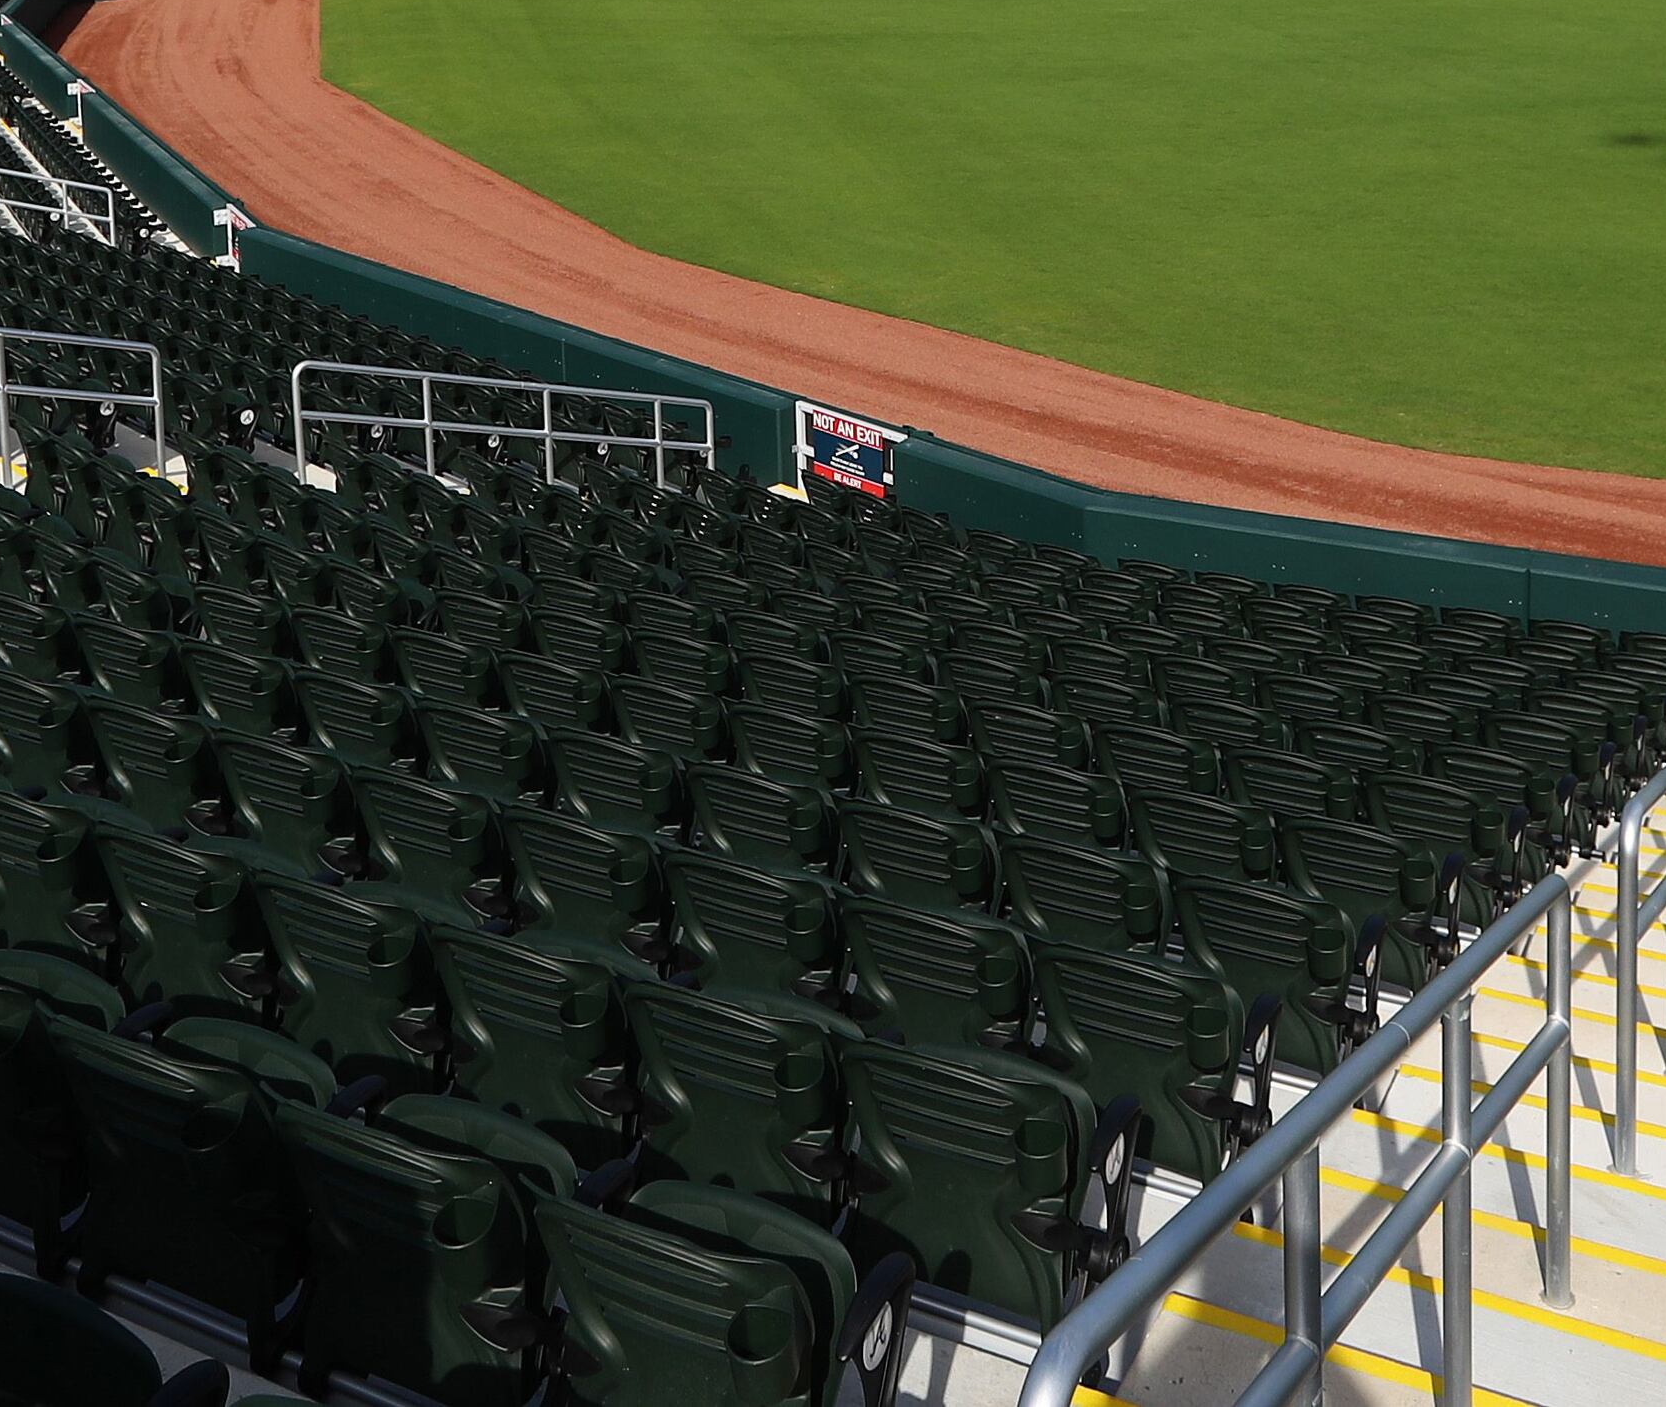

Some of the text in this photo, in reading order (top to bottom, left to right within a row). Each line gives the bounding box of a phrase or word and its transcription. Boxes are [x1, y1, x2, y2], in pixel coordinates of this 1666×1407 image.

[813, 412, 882, 447] NOT AN EXIT
[843, 475, 862, 490] ALERT
